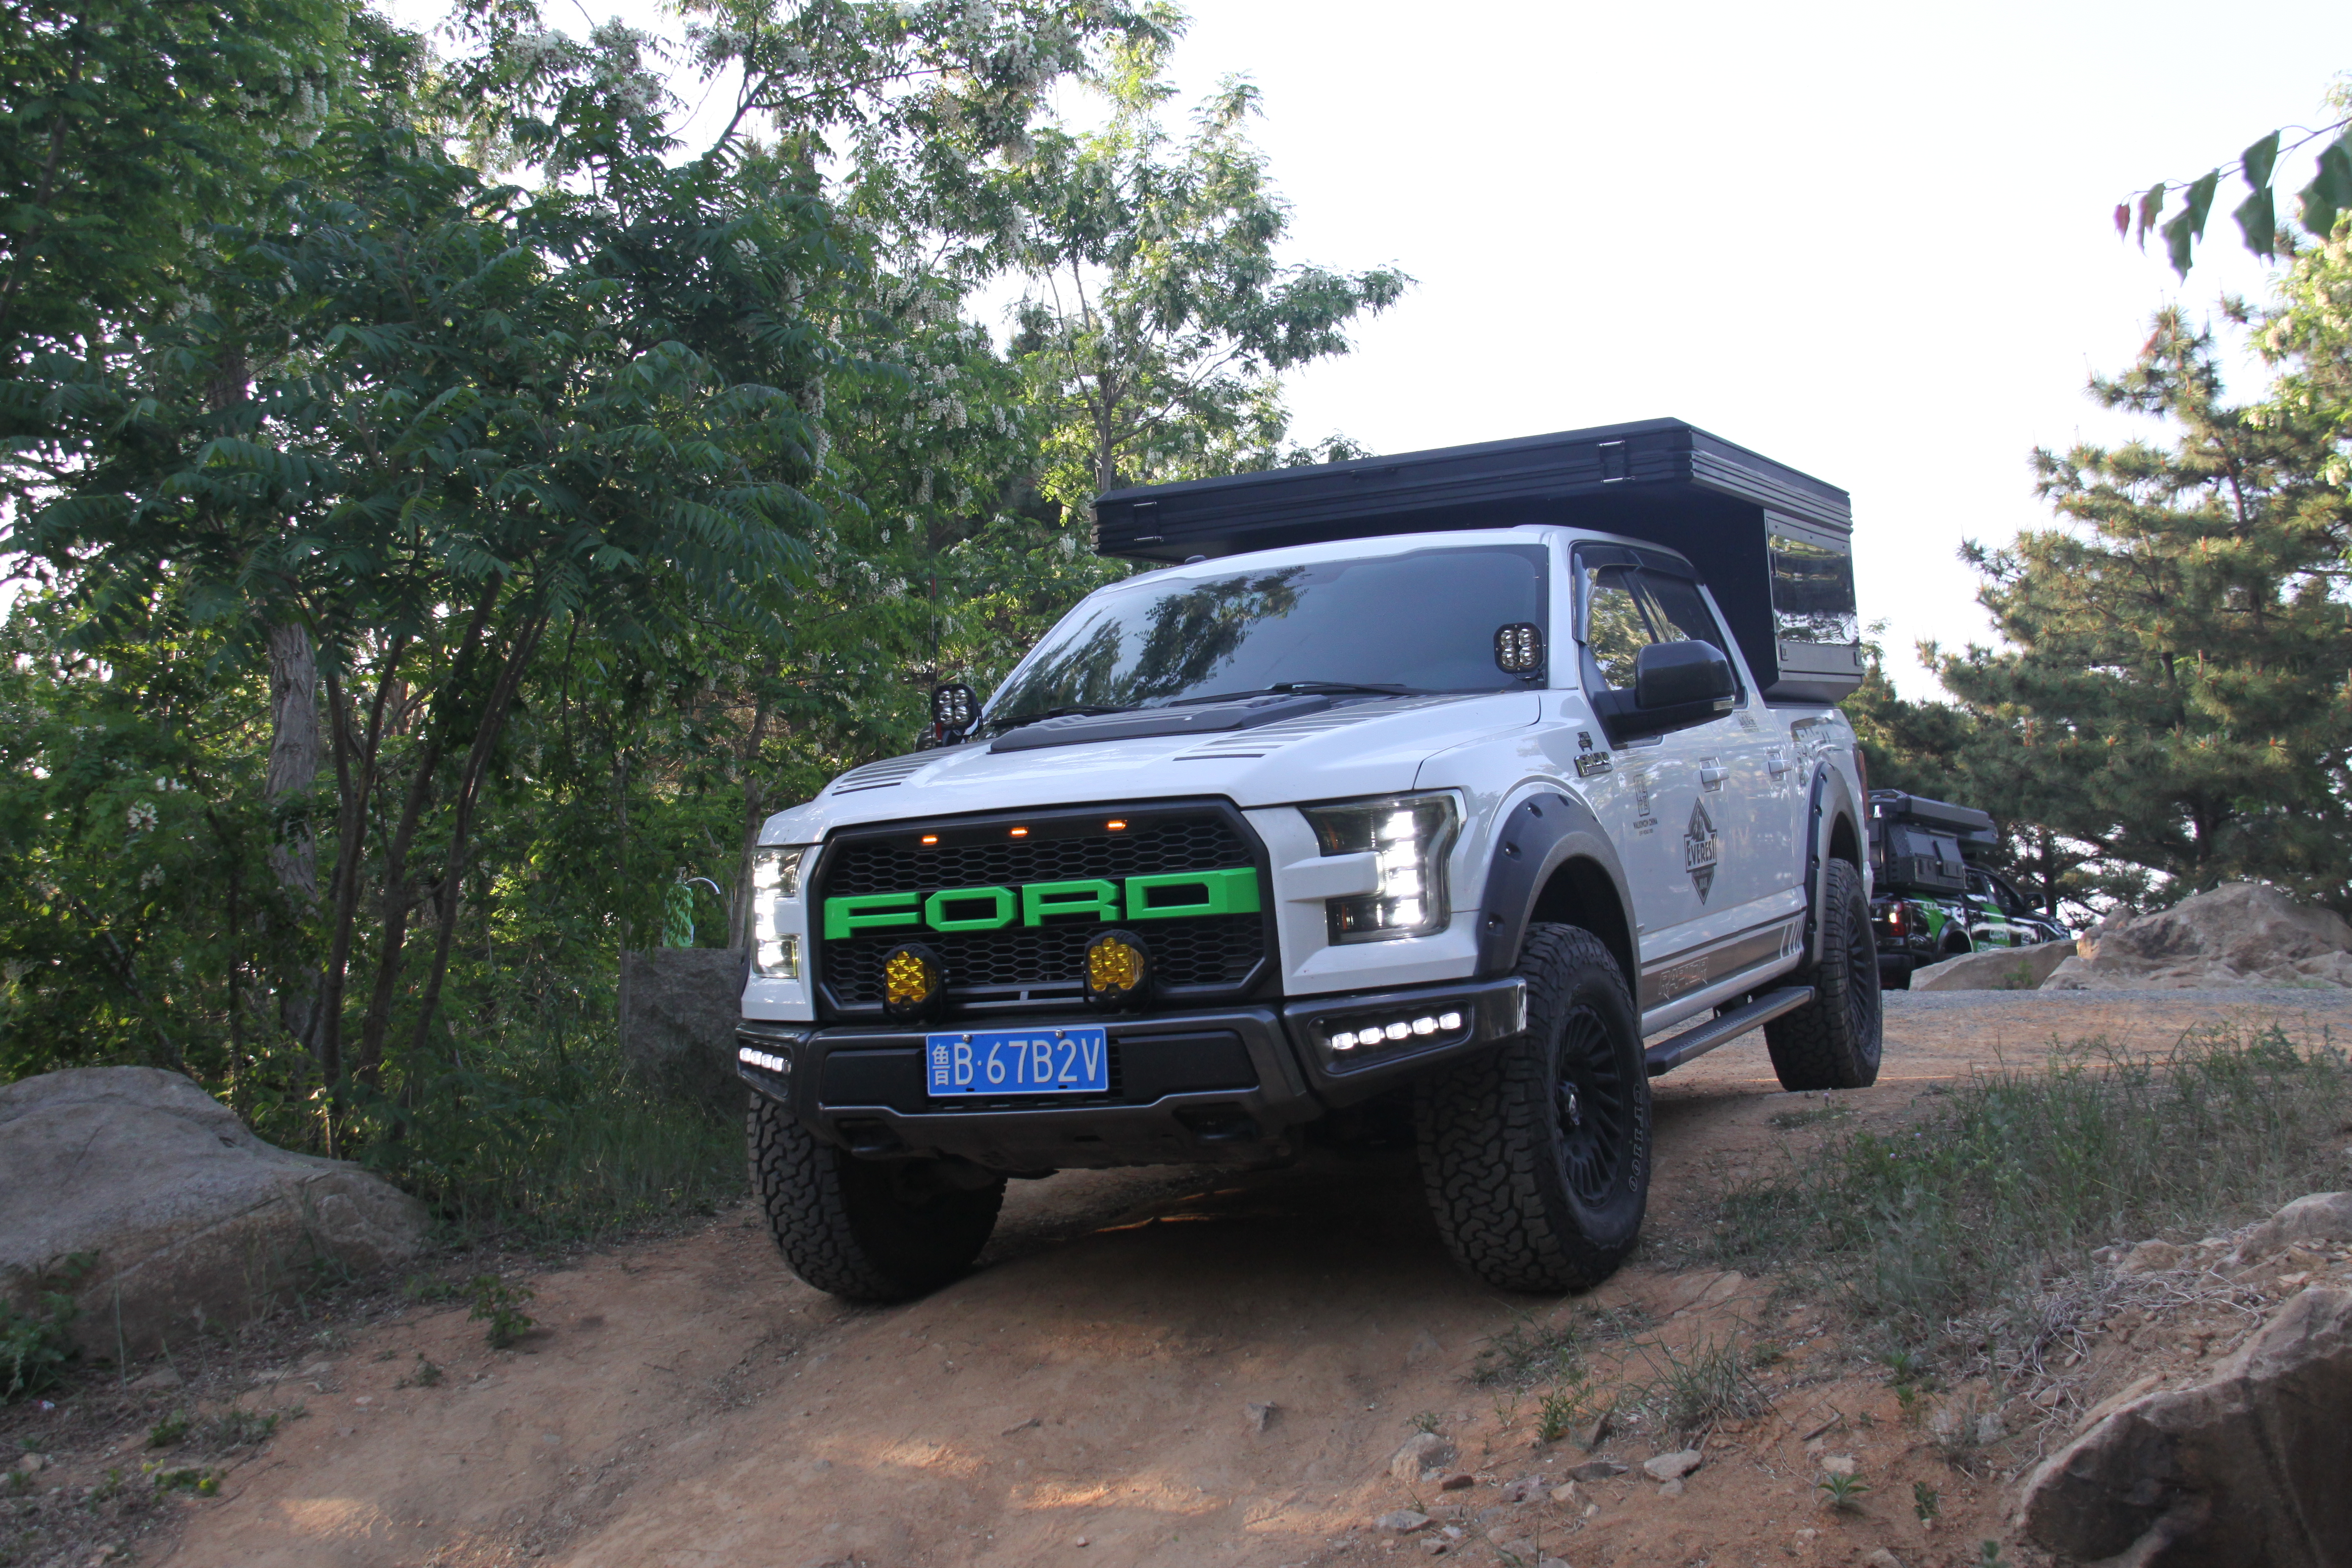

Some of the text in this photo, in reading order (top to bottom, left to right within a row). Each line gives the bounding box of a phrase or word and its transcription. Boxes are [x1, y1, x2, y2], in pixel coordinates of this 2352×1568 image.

[1686, 833, 1715, 866] EVEREST
[824, 867, 1261, 940] FORD
[1658, 957, 1709, 1000] RAPTOR
[932, 1037, 1100, 1086] 鲁B·67B2V
[1629, 1083, 1644, 1192] CF1100
